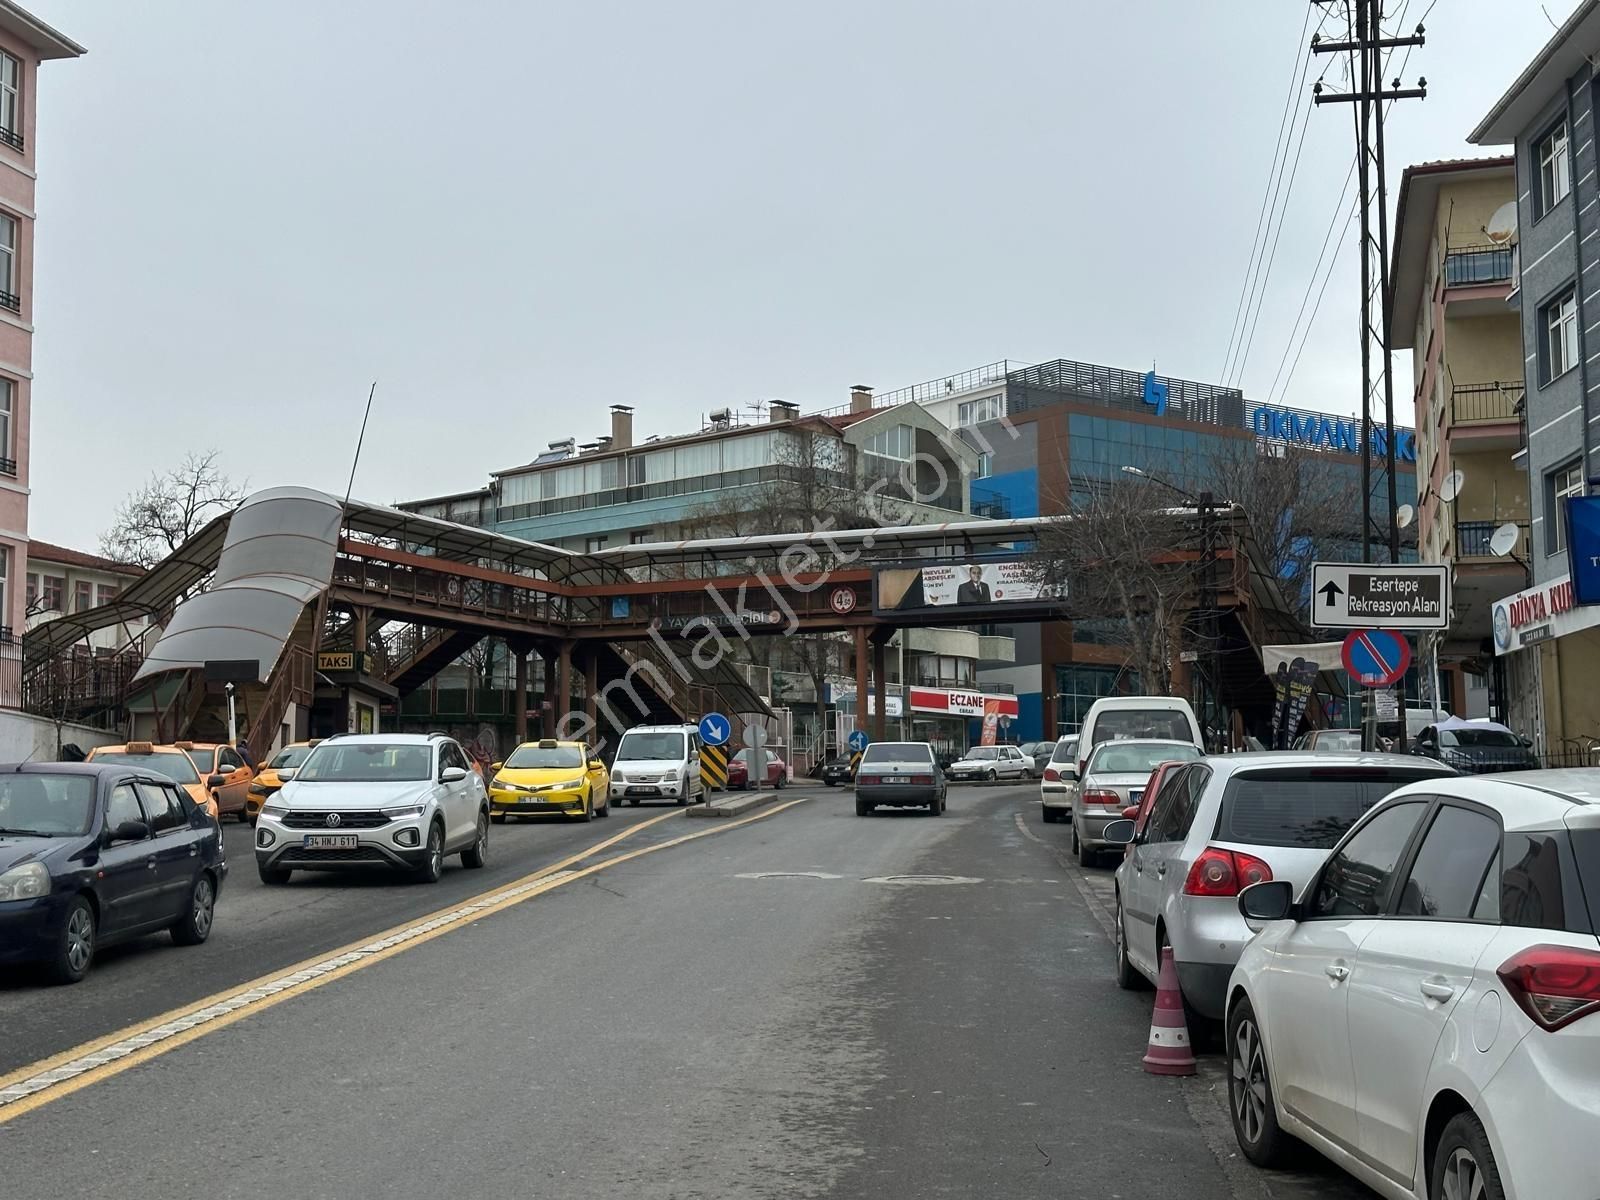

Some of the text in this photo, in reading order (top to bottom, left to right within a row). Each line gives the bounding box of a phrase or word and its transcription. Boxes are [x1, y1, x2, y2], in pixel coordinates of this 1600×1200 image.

[1254, 407, 1355, 452] OKMAN
[1369, 577, 1418, 596] Esertepe
[1349, 595, 1439, 616] Rekreasyon Alanı
[1509, 592, 1547, 629] DÜNYA
[319, 655, 352, 668] TAKSİ
[950, 693, 983, 708] ECZANE
[309, 837, 355, 847] 34 HNJ 611
